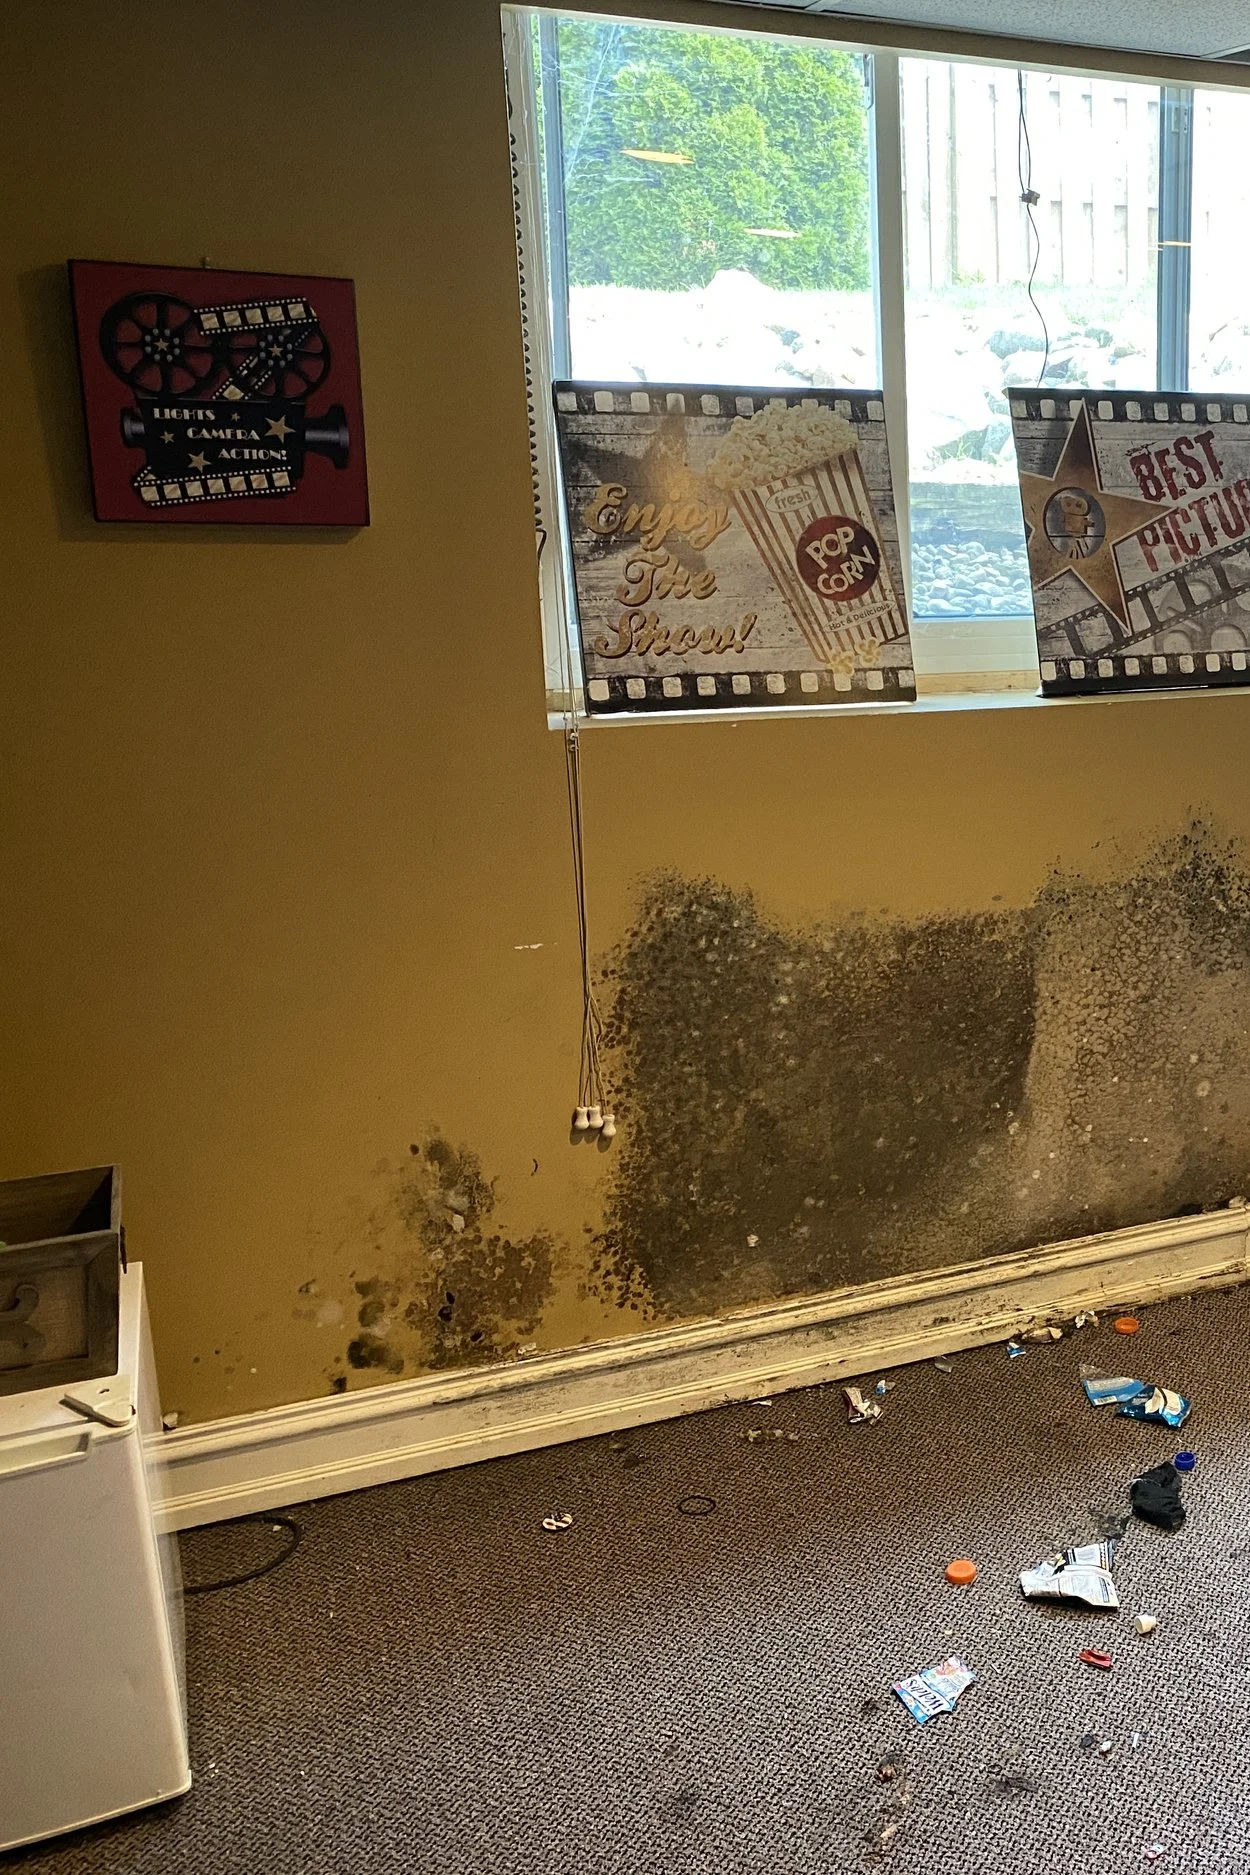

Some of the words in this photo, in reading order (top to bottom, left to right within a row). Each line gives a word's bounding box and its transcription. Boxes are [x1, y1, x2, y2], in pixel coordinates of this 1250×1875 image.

[153, 407, 216, 420] LIGHTS
[186, 427, 261, 440] CAMERA
[218, 448, 287, 460] ACTION!
[1129, 430, 1224, 502] BEST
[584, 482, 732, 551] Enjoy
[774, 488, 812, 510] fresh
[804, 526, 855, 570] POP
[816, 545, 876, 595] CORN
[616, 551, 718, 608] The
[594, 608, 758, 659] Show!
[828, 620, 845, 631] Hot
[853, 602, 891, 621] Delicious
